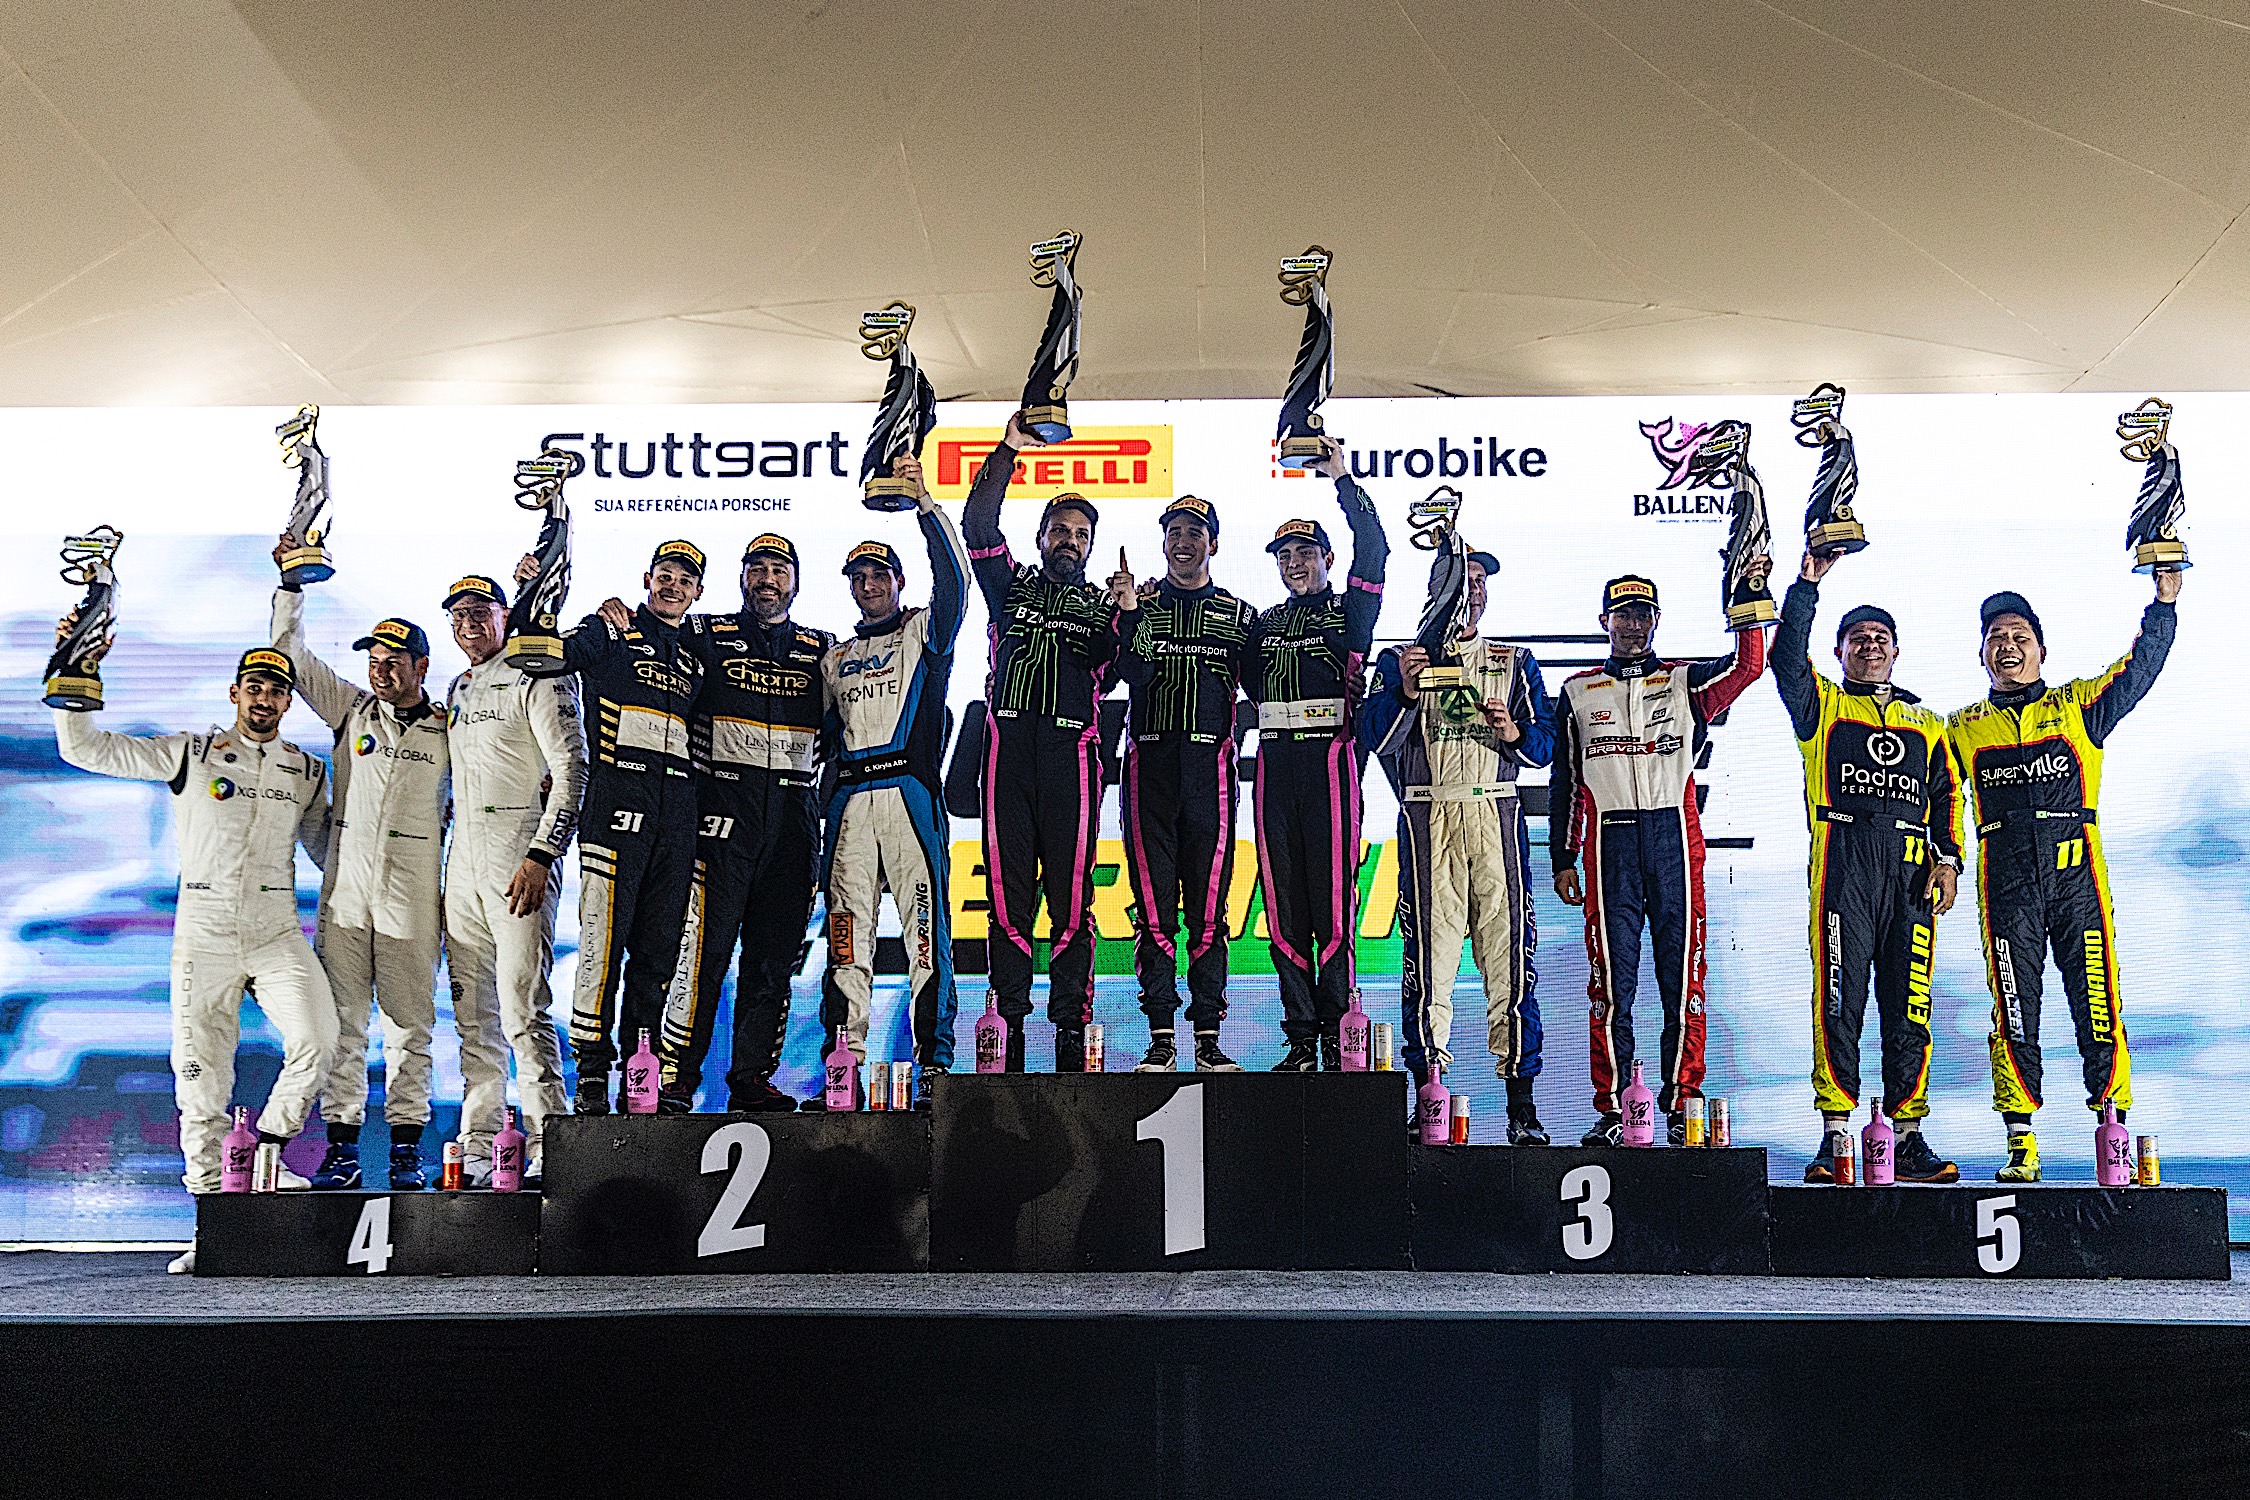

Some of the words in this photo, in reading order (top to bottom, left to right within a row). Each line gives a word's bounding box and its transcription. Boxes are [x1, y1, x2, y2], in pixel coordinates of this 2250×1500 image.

[541, 432, 848, 478] Stuttgart
[595, 499, 624, 512] SUA
[722, 499, 791, 511] PORSCHE
[1841, 507, 1849, 518] 5
[1614, 583, 1650, 596] PIRELLI
[1753, 578, 1761, 588] 3
[544, 616, 553, 626] 2
[740, 683, 798, 697] BLINDAGENS
[1468, 724, 1492, 735] Alta
[1841, 763, 1920, 794] Padron
[1842, 785, 1921, 805] PERFUMARIA
[610, 810, 645, 833] 31
[699, 815, 735, 839] 31
[1827, 811, 1854, 824] sparco
[1903, 835, 1924, 865] 11
[2056, 838, 2084, 870] 11
[834, 914, 850, 965] KIRYLA
[1907, 923, 1932, 1025] EMILIO
[2084, 929, 2113, 1043] FERNANDO
[1136, 1083, 1205, 1255] 1
[697, 1122, 771, 1257] 2
[1561, 1165, 1614, 1260] 3
[347, 1197, 393, 1273] 4
[1976, 1194, 2021, 1273] 5
